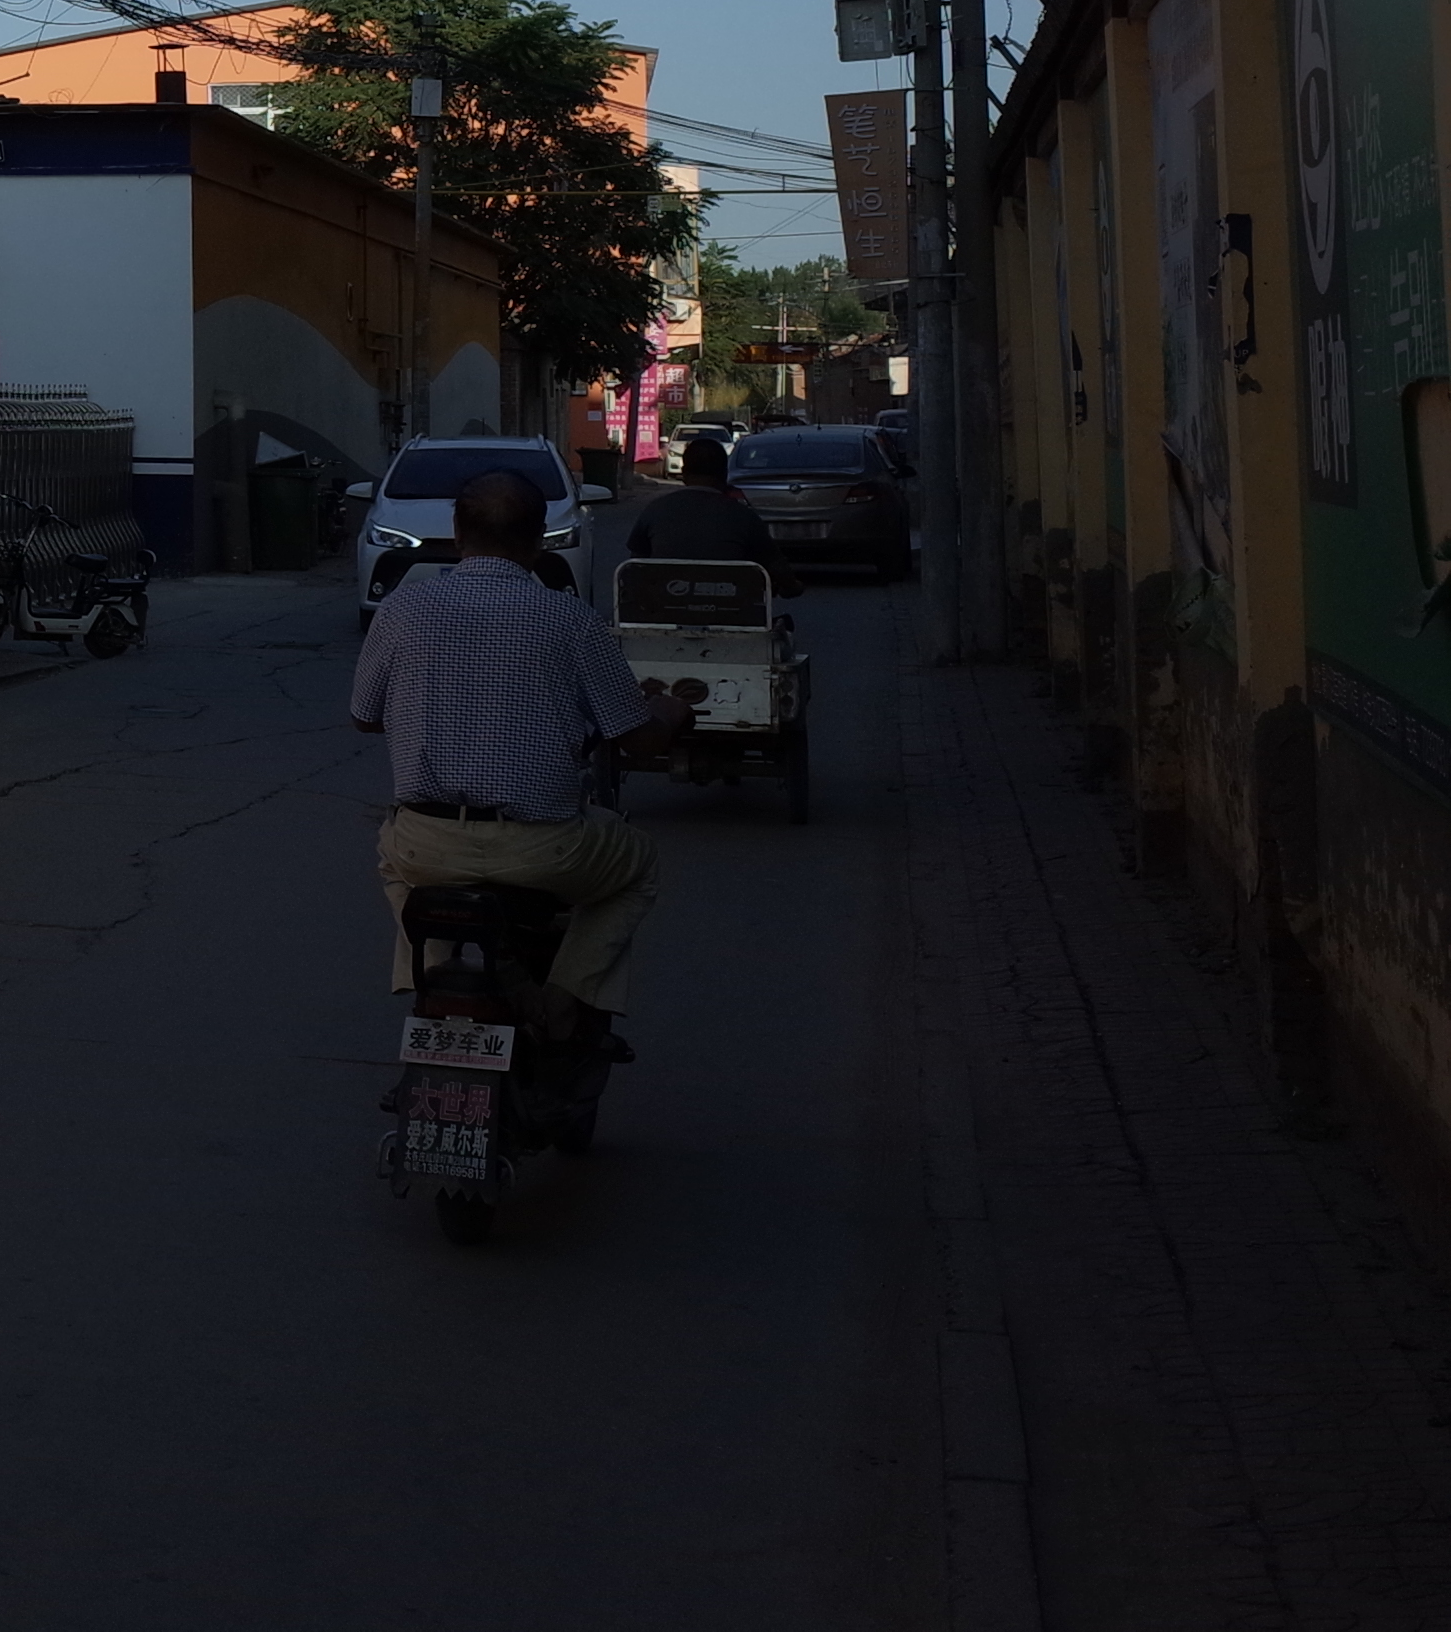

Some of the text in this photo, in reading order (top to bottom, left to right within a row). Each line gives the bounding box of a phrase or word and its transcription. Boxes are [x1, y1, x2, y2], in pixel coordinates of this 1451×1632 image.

[837, 103, 887, 258] 笔艺恒生
[665, 367, 686, 403] 超市
[409, 1027, 505, 1057] 爱梦车业
[408, 1077, 491, 1126] 大世界
